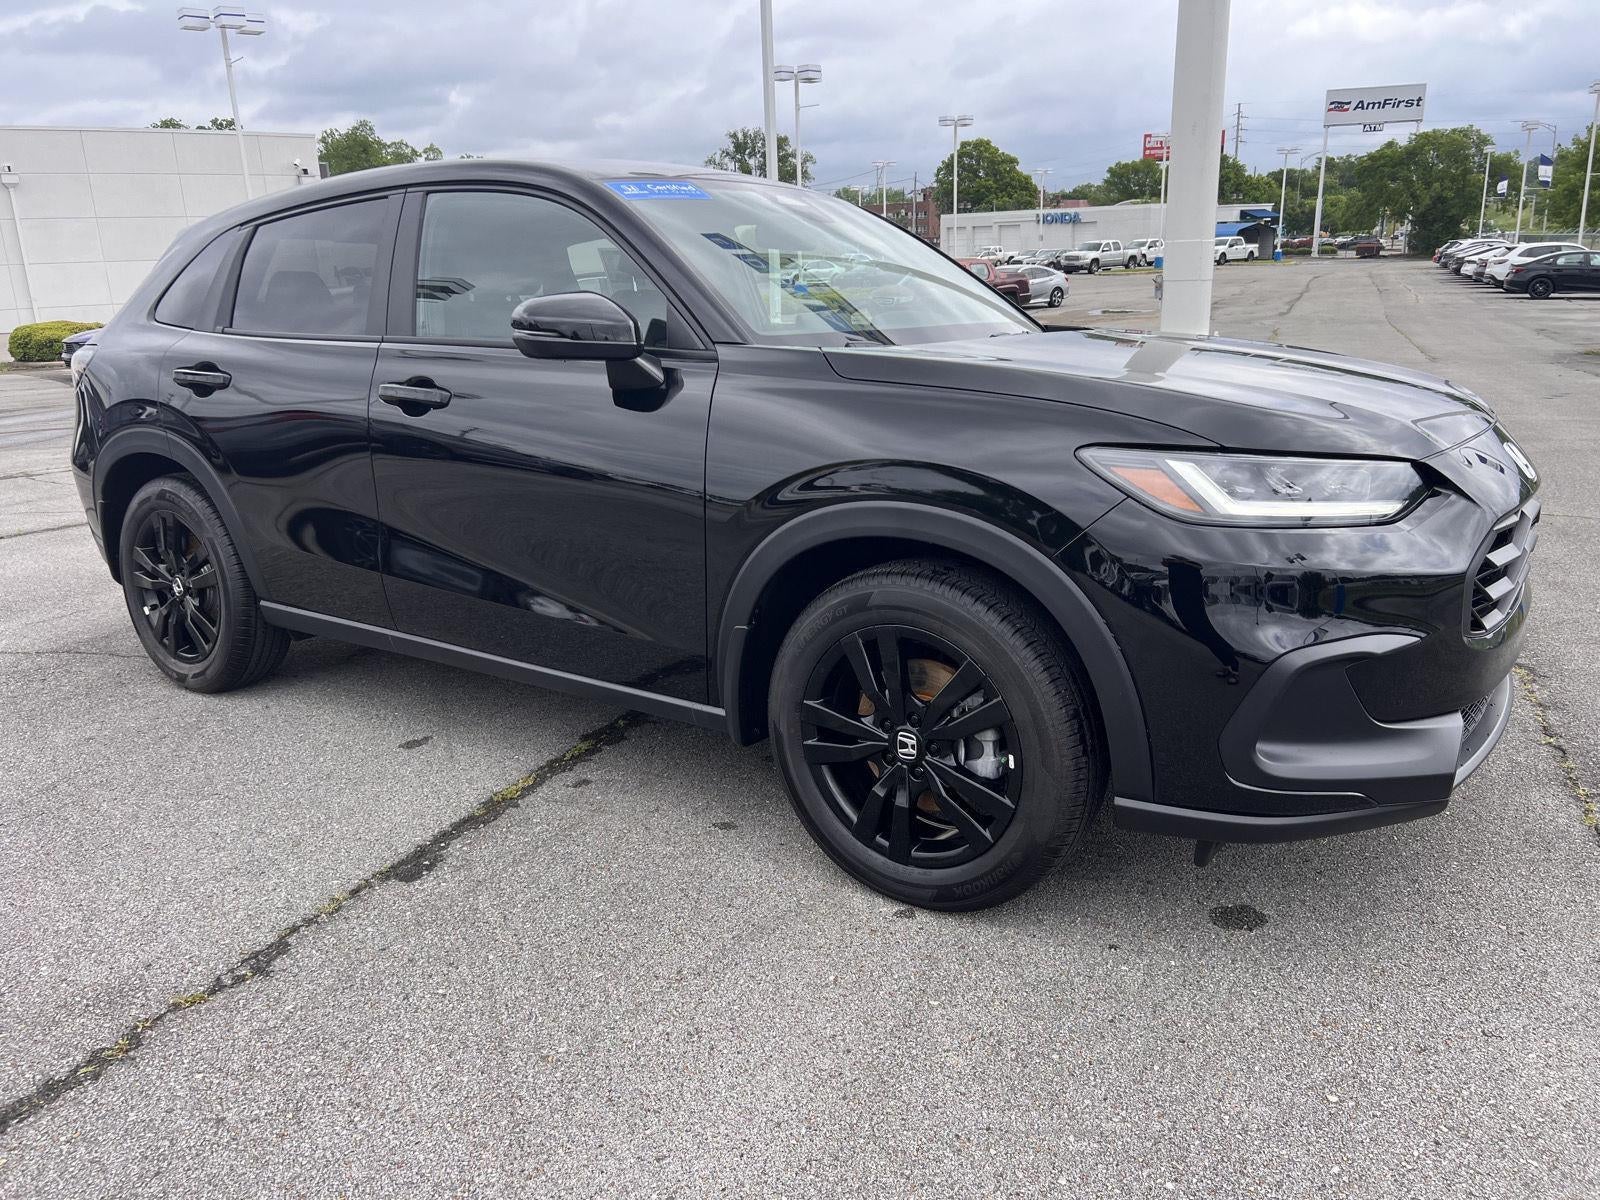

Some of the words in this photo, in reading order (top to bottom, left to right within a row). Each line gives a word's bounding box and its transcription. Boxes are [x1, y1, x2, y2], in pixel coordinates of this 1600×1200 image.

[1353, 96, 1423, 111] AmFirst
[1363, 123, 1384, 132] ATM
[1036, 211, 1081, 225] HONDA
